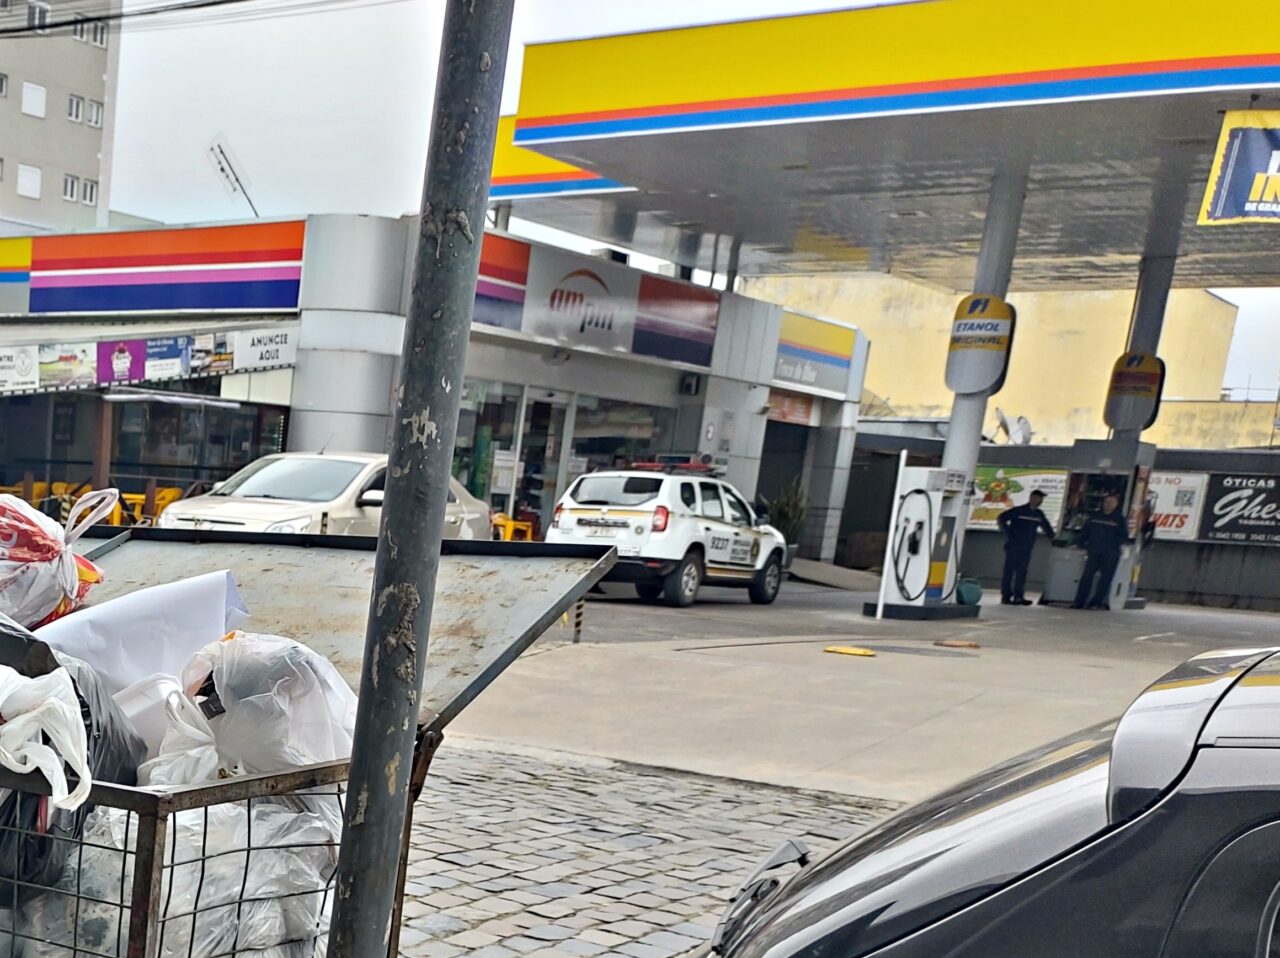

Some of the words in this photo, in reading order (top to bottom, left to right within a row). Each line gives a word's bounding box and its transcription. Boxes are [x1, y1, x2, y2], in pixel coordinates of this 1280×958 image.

[956, 322, 1000, 332] ETANOL
[250, 334, 289, 348] ANUNCIE
[259, 349, 280, 361] AQUI
[1222, 476, 1275, 488] ÓTICAS
[710, 536, 729, 550] 9237
